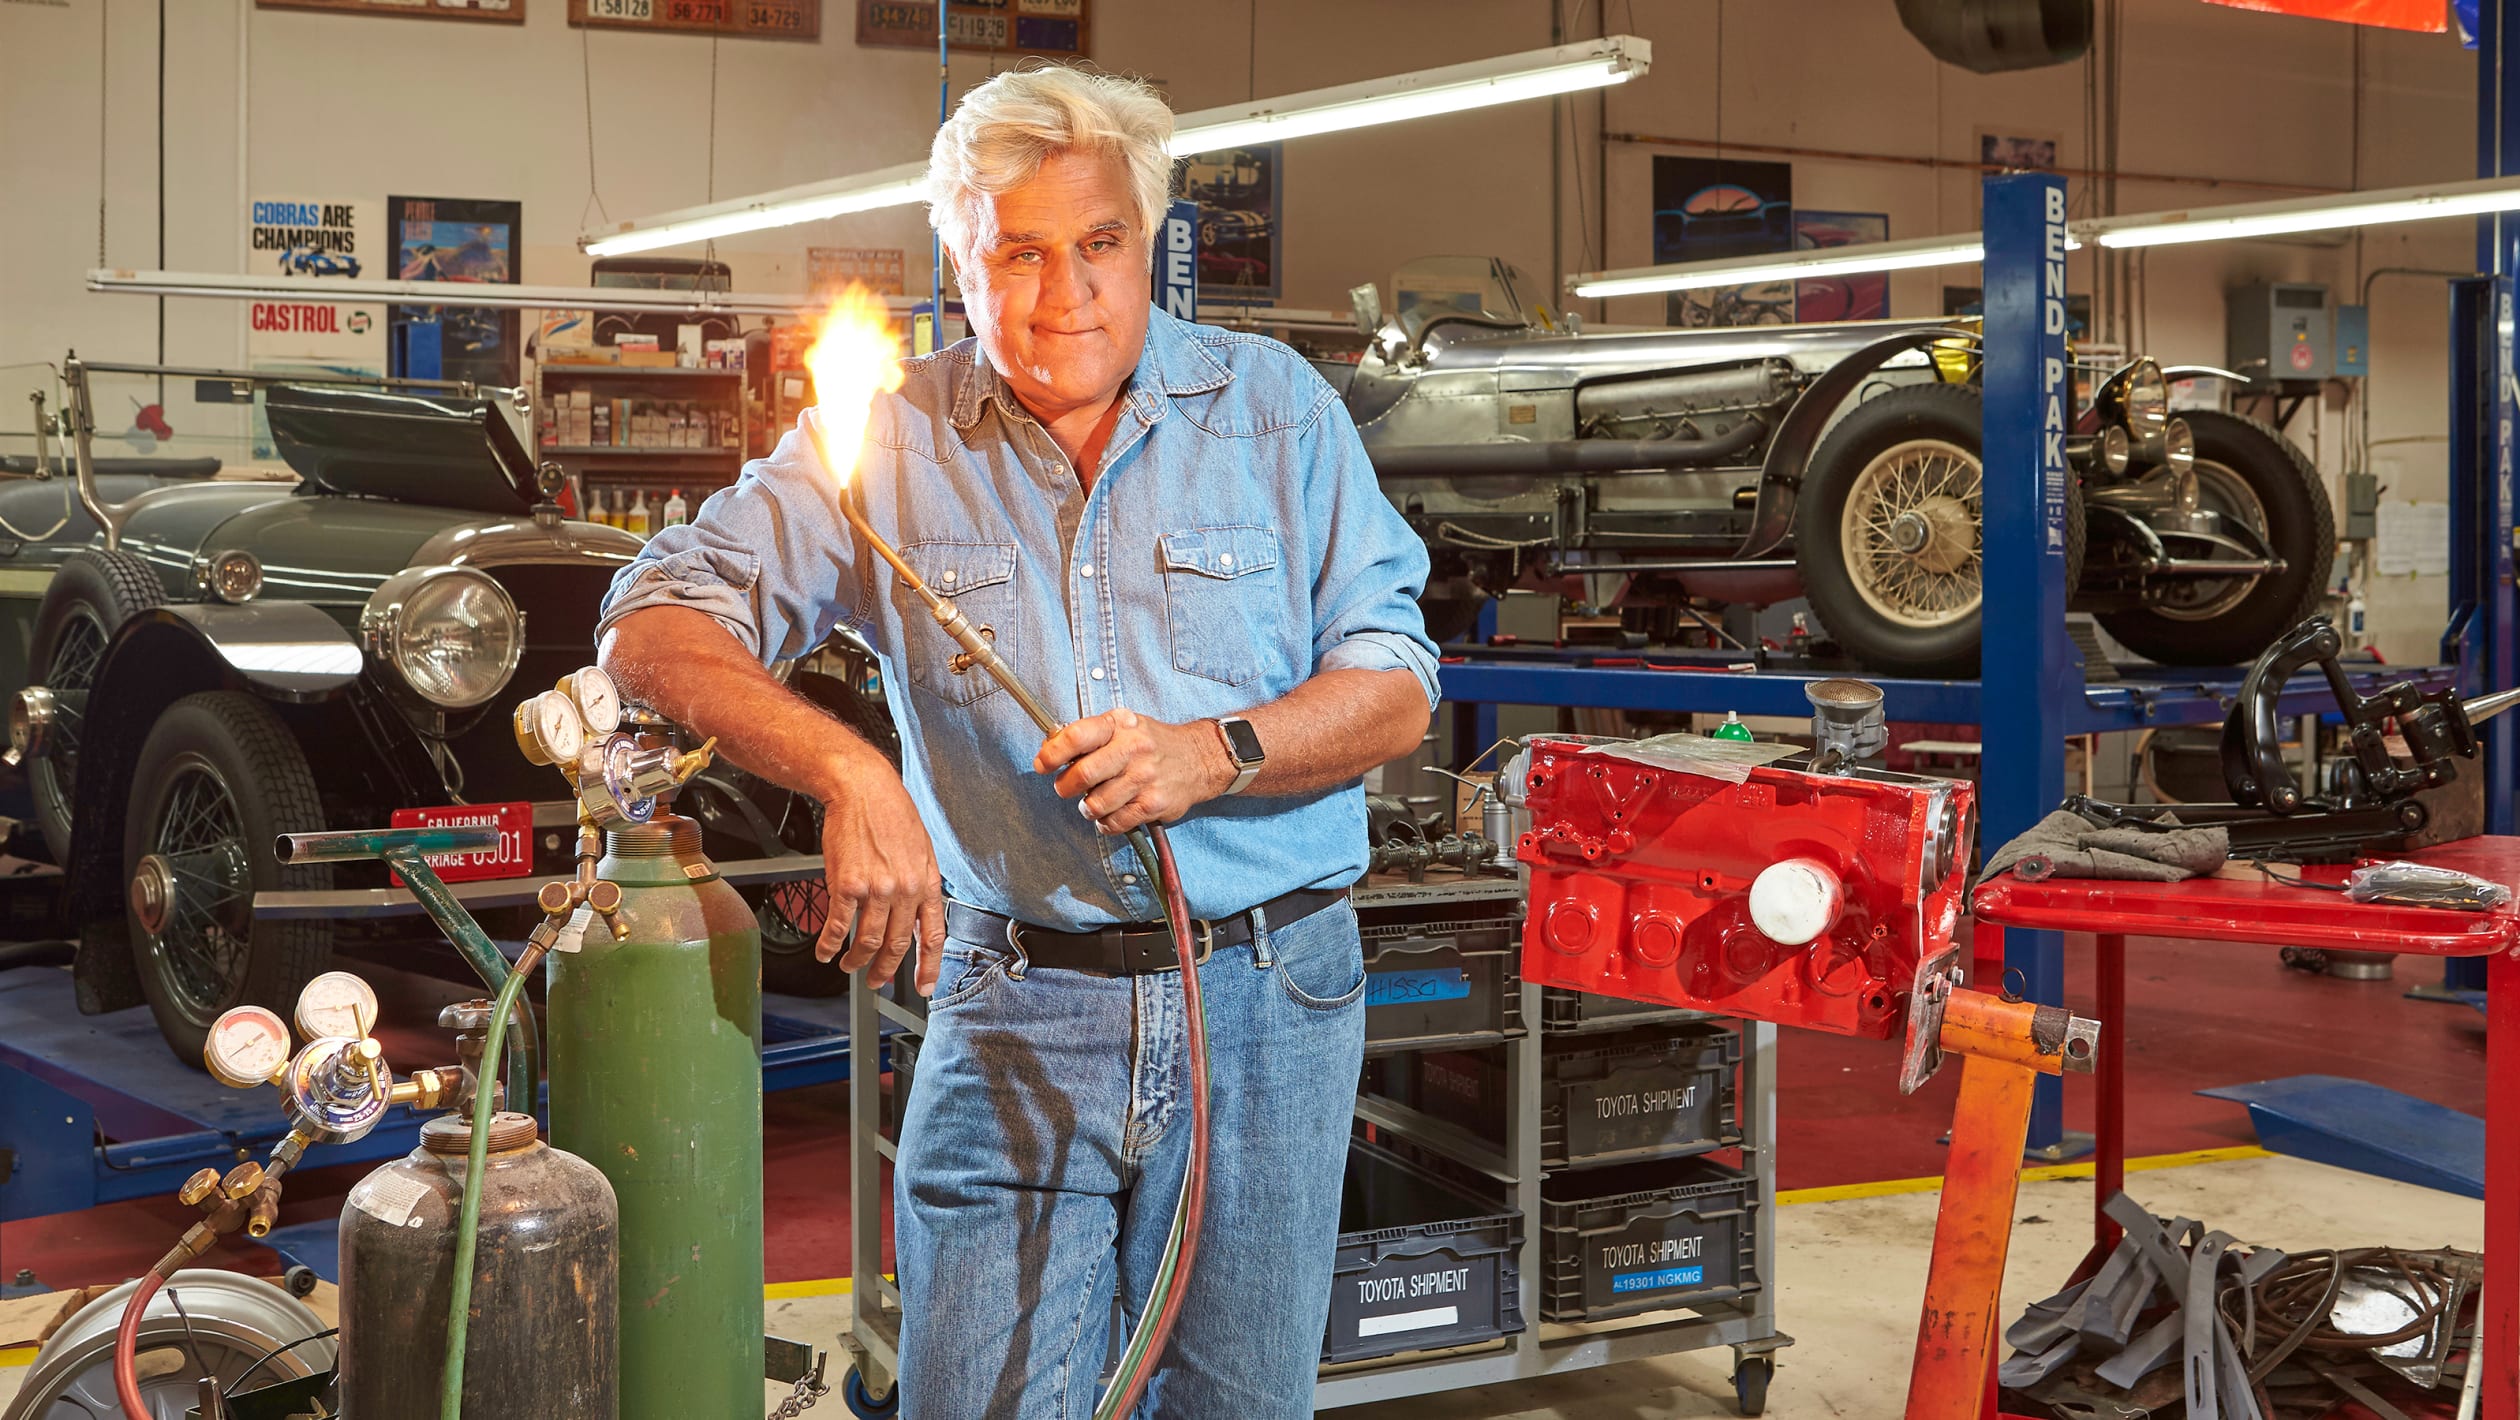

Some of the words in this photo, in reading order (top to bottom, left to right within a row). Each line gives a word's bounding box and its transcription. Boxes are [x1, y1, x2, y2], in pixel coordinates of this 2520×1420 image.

[253, 202, 319, 226] COBRAS
[322, 205, 355, 228] ARE
[252, 227, 355, 253] CHAMPIONS
[2045, 187, 2065, 336] BEND
[252, 303, 340, 333] CASTROL
[2045, 357, 2065, 468] PAK
[427, 815, 499, 828] CALIFORNIA
[1596, 1093, 1639, 1119] TOYOTA
[1643, 1086, 1696, 1113] SHIPMENT
[1602, 1243, 1646, 1269] TOYOTA
[1650, 1236, 1703, 1263] SHIPMENT
[1358, 1277, 1406, 1304] TOYOTA
[1410, 1268, 1469, 1297] SHIPMENT
[1657, 1270, 1701, 1286] NGKMG
